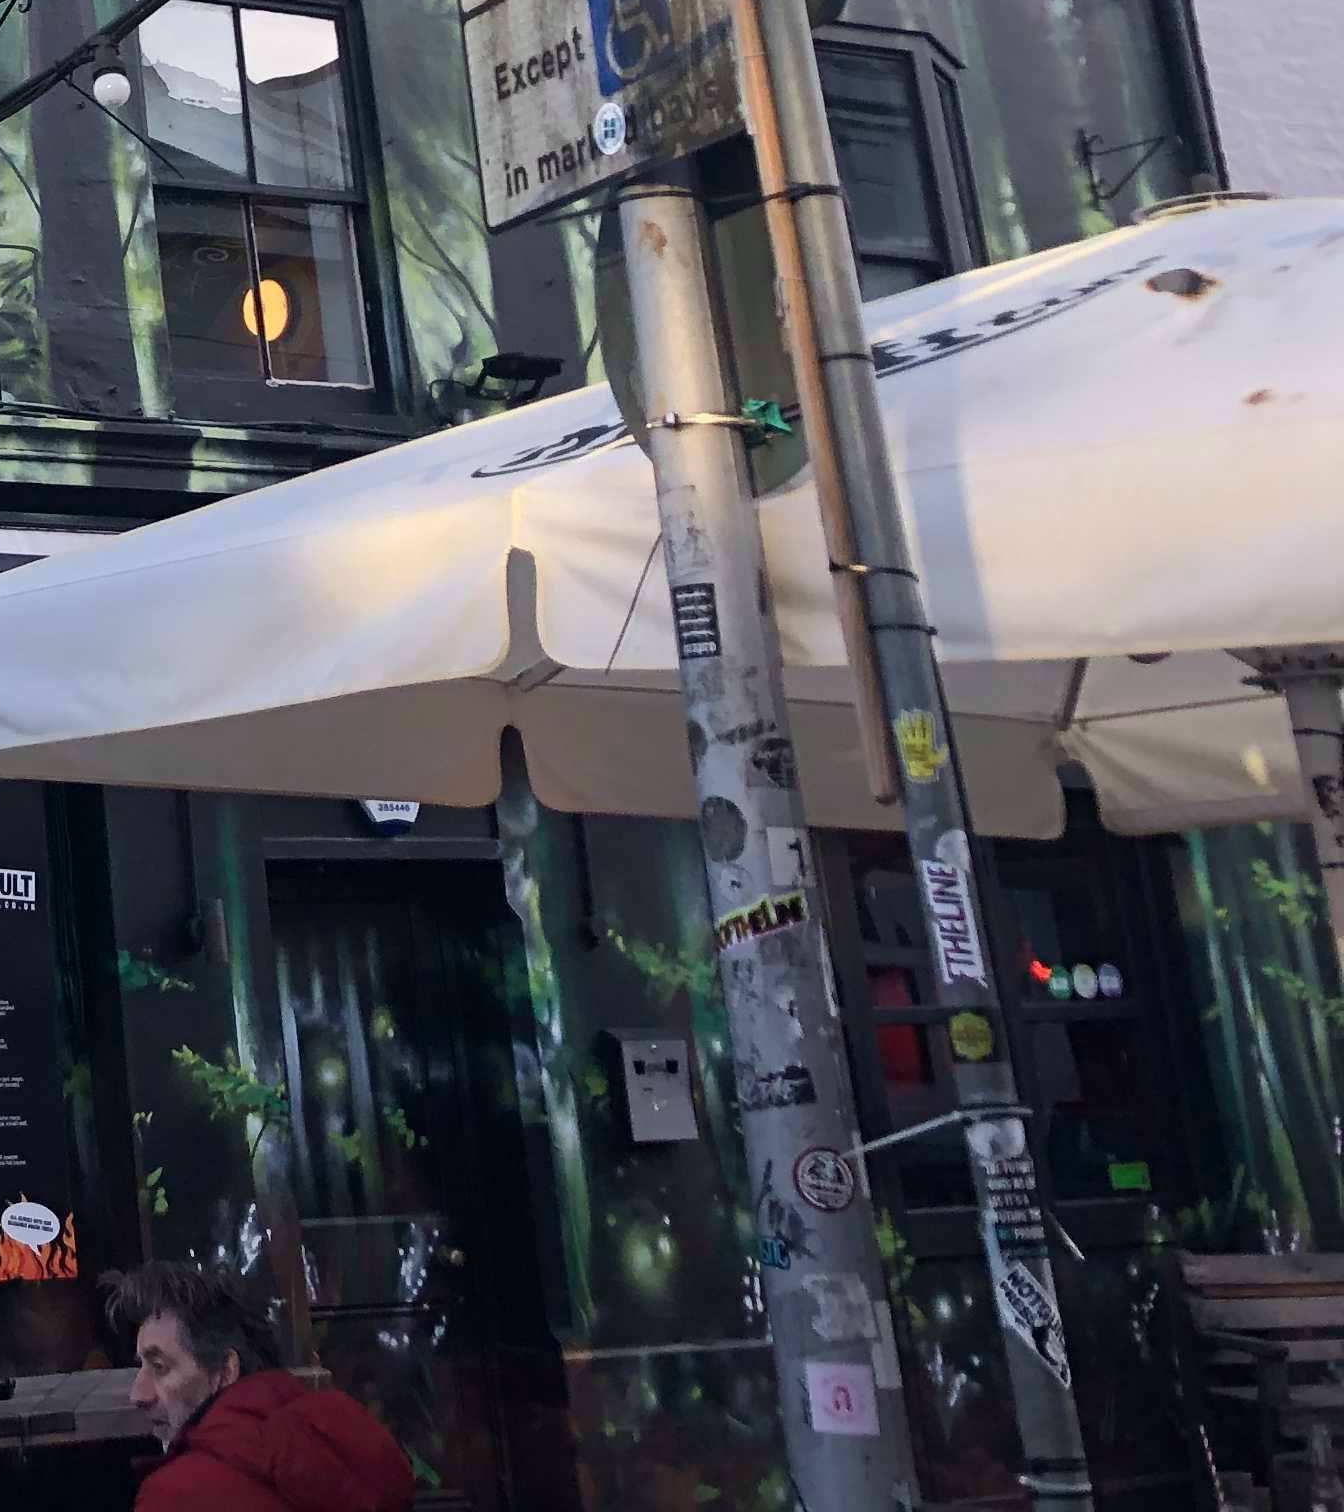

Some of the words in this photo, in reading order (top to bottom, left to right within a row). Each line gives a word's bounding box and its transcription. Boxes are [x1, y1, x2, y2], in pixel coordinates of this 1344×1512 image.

[495, 26, 585, 102] Except
[504, 162, 529, 198] in
[538, 102, 638, 184] mard
